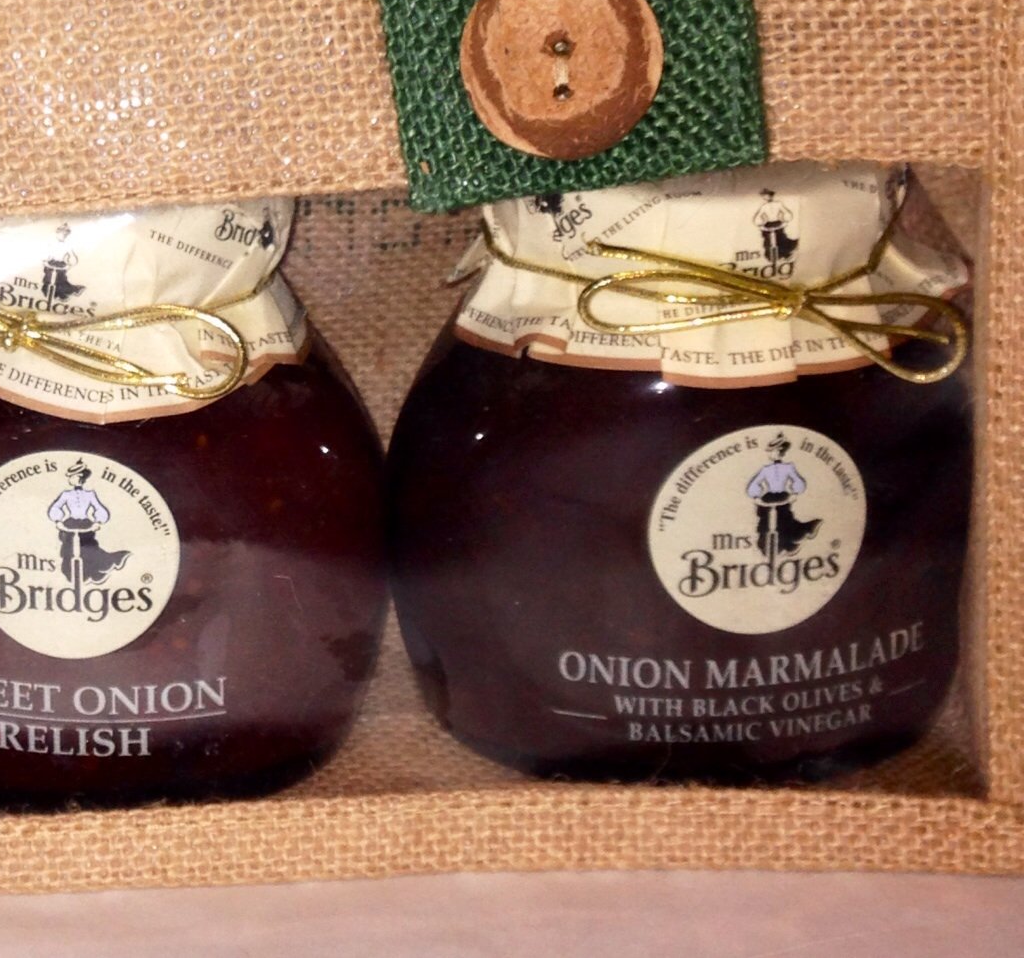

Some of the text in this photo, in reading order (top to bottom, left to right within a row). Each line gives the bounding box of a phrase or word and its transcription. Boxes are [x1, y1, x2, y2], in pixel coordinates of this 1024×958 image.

[622, 196, 662, 225] LIVING
[149, 229, 234, 270] THE DIFFERENCE
[735, 250, 761, 262] mrs
[13, 276, 39, 290] mrs
[728, 350, 765, 366] THE
[805, 338, 824, 353] IN
[120, 385, 140, 401] IN
[44, 459, 59, 473] is
[676, 441, 743, 497] difference
[744, 435, 759, 451] is
[799, 437, 815, 454] in
[815, 445, 837, 467] the
[100, 466, 117, 484] in
[117, 476, 141, 498] the
[712, 531, 753, 550] mrs
[17, 552, 57, 572] mrs
[557, 620, 927, 692] ONION MARMALADE
[72, 674, 228, 717] ONION
[613, 675, 885, 719] WITH BLACK OLIVES &
[628, 702, 874, 744] BALSAMIC VINEGAR
